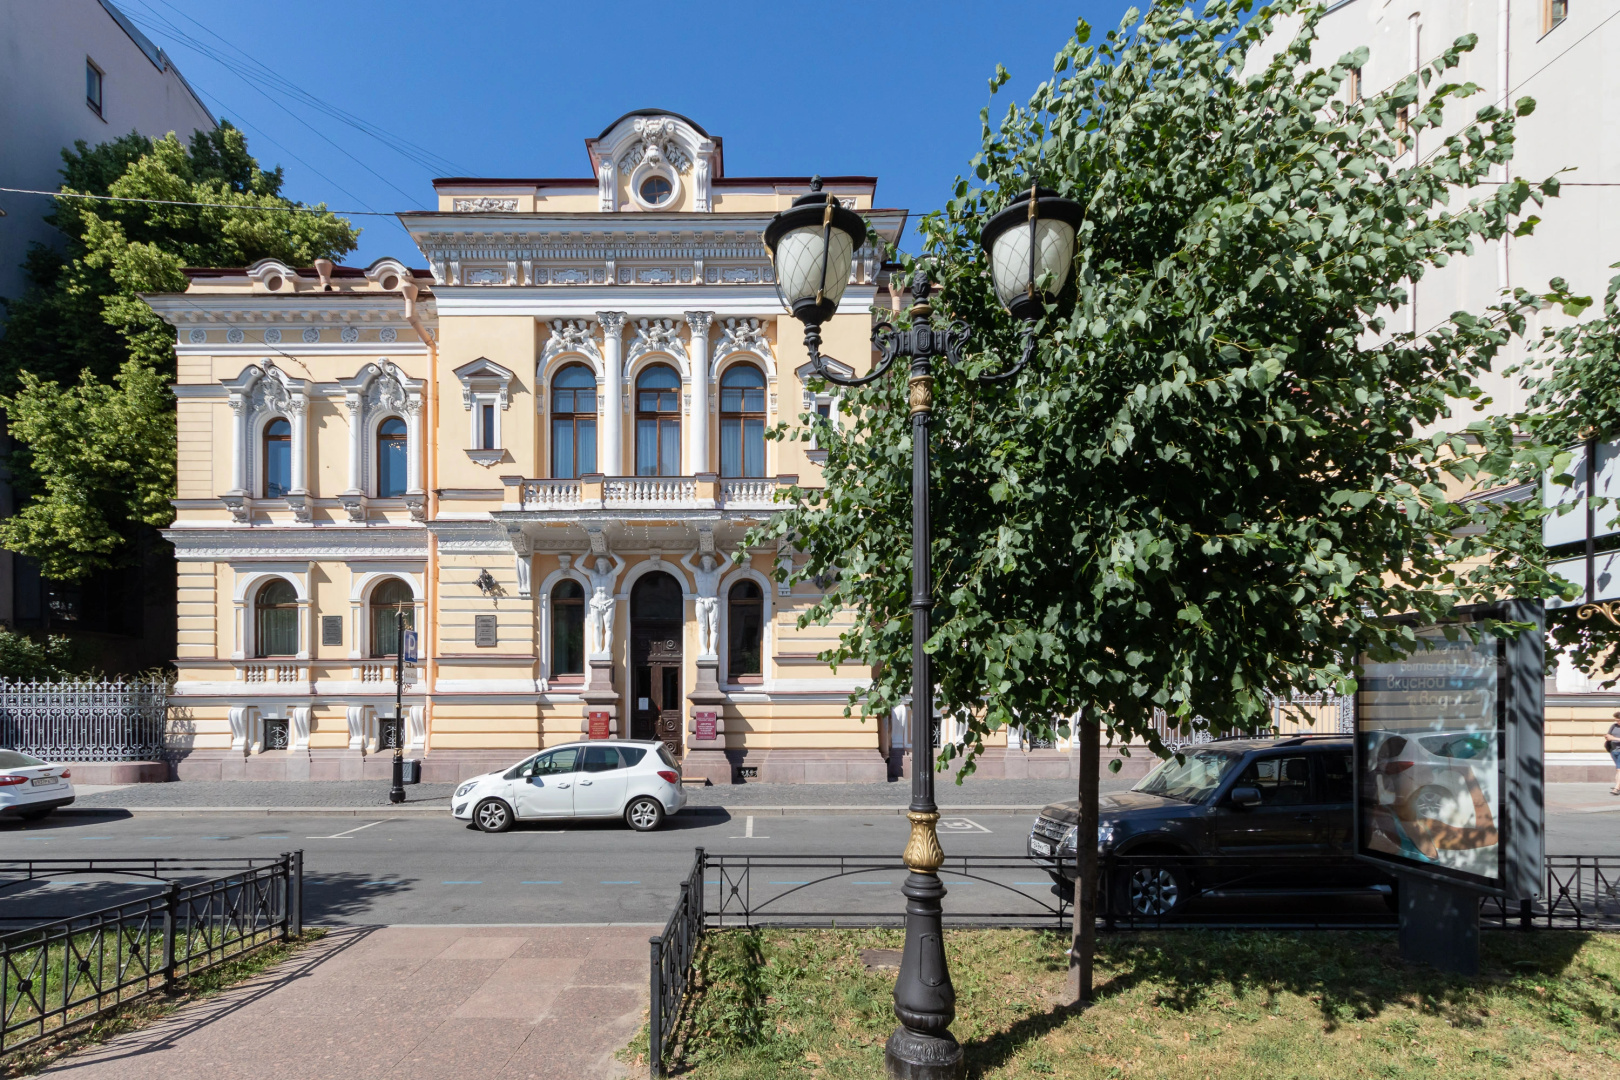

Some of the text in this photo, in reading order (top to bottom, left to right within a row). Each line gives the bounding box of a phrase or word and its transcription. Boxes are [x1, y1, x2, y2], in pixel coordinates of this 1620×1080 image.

[408, 634, 416, 659] P
[1400, 660, 1433, 672] быть
[1386, 674, 1446, 693] вкусной
